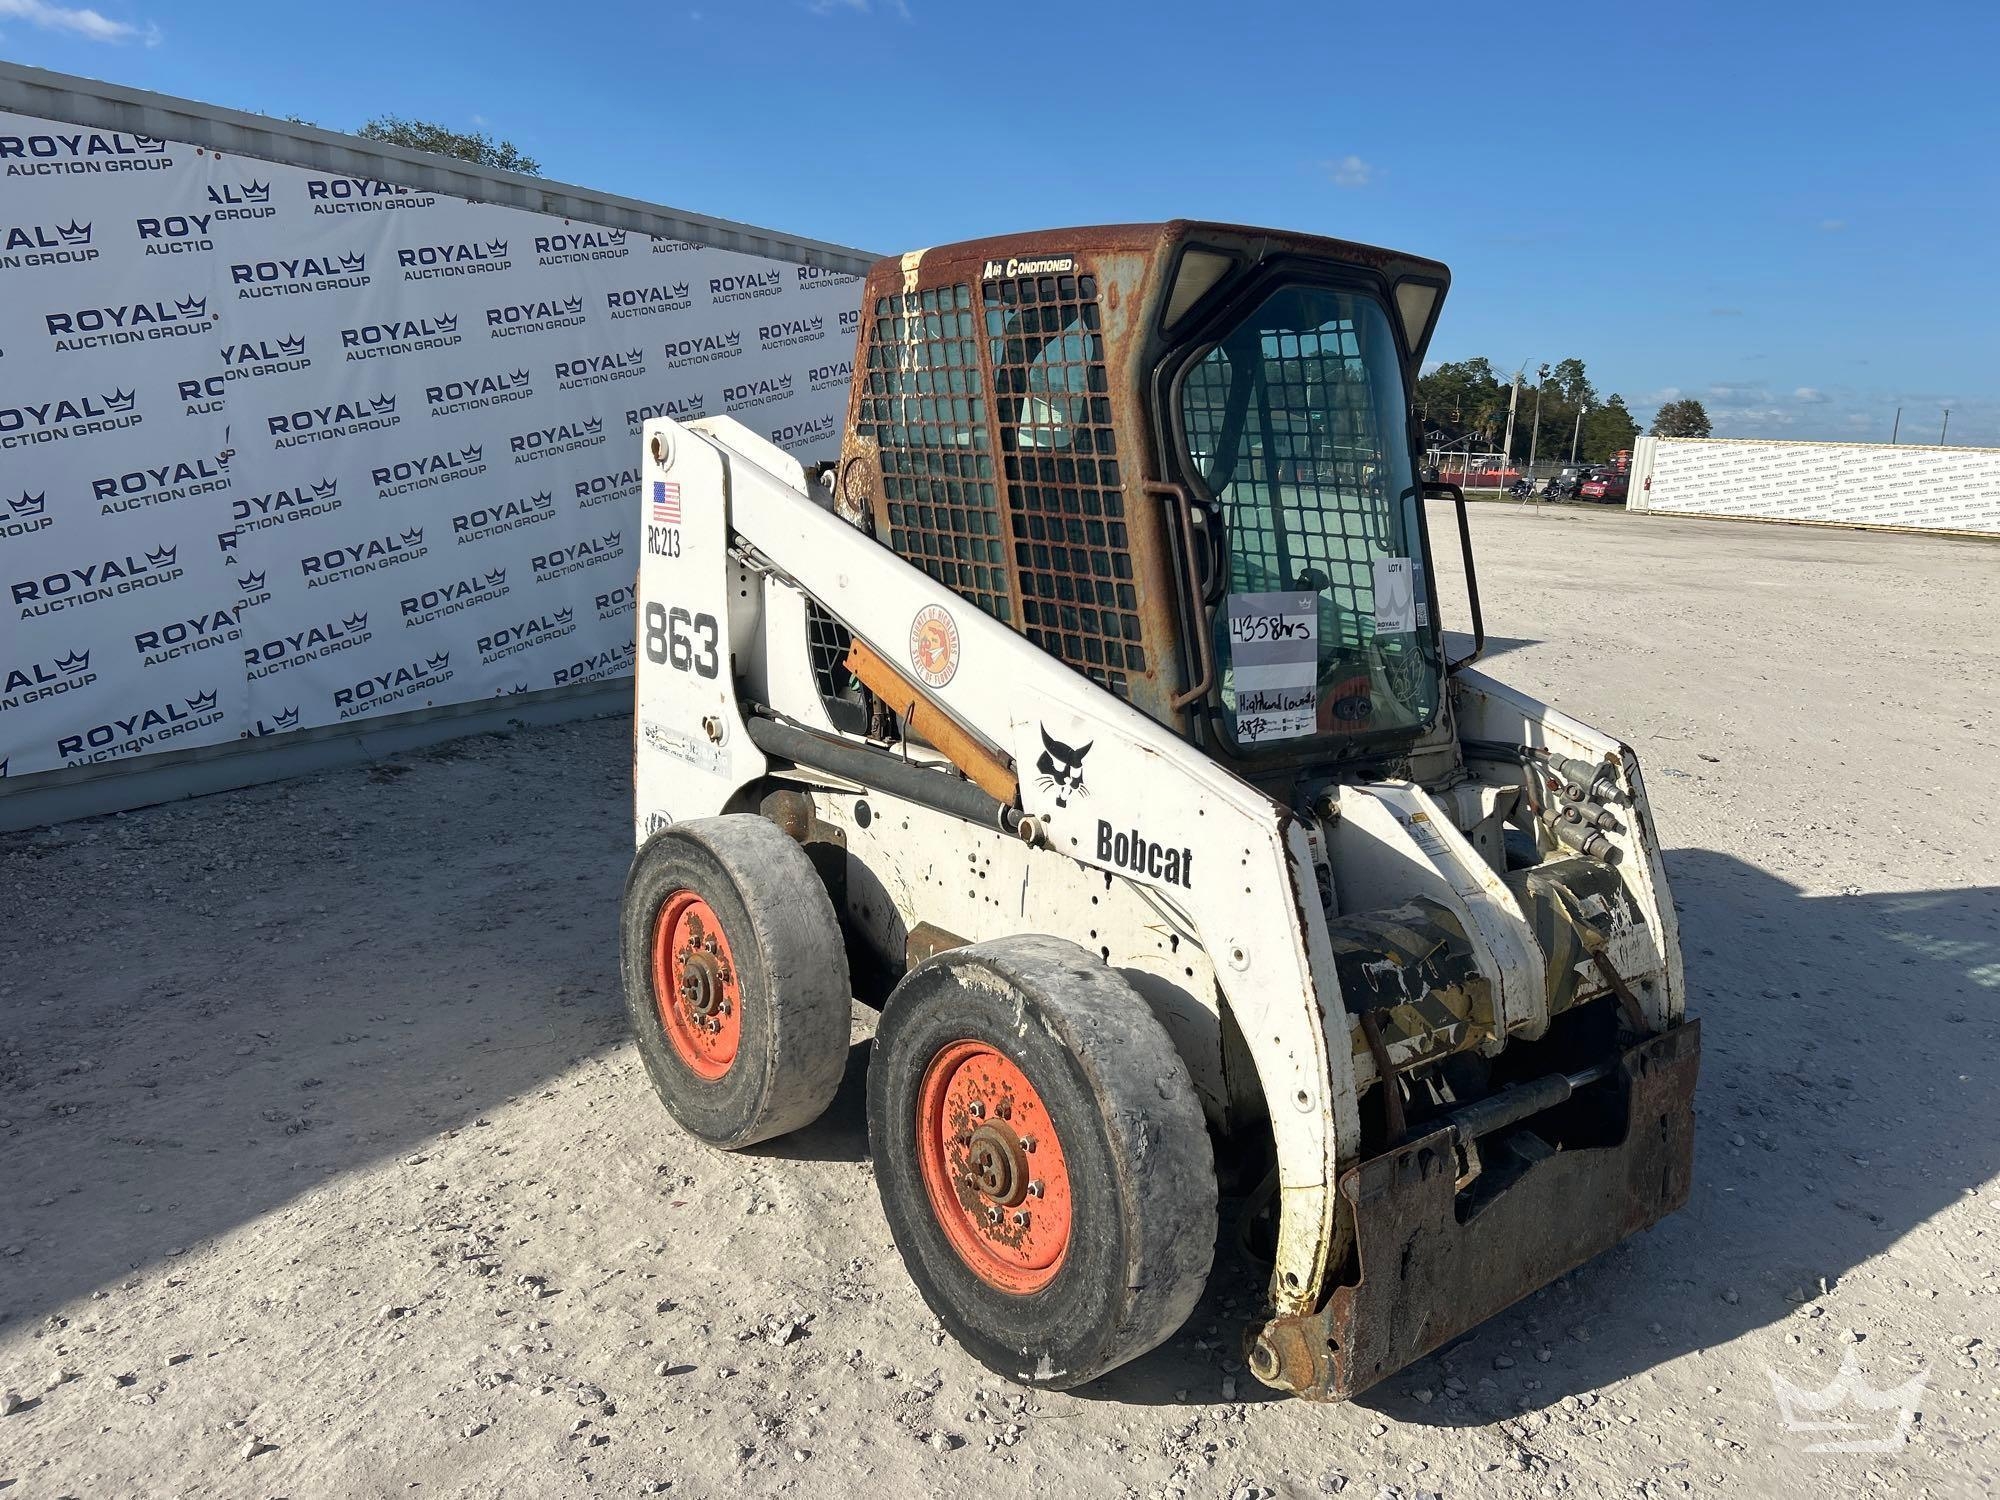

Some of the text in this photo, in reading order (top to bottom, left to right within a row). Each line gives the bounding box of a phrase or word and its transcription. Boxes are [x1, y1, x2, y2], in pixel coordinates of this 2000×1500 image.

[0, 134, 135, 157] ROYAL
[7, 158, 172, 176] AUCTION GROUP
[214, 207, 275, 220] GROUP
[314, 198, 435, 214] AUCTION GROUP
[137, 215, 211, 239] ROY
[398, 243, 487, 266] ROYAL
[535, 232, 609, 253] ROYAL
[25, 250, 100, 266] GROUP
[230, 257, 341, 284] ROYAL
[404, 262, 512, 281] AUCTION GROUP
[539, 249, 628, 266] AUCTION GROUP
[239, 277, 370, 299] AUCTION GROUP
[607, 286, 673, 308] ROYAL
[710, 273, 767, 294] ROYAL
[712, 287, 782, 304] AUCTION GROUP
[800, 276, 859, 290] AUCTION GROUP
[46, 302, 176, 335] ROYAL
[486, 301, 564, 326] ROYAL
[611, 301, 691, 320] AUCTION GROUP
[839, 311, 861, 325] RO
[56, 322, 212, 351] AUCTION GROUP
[341, 319, 435, 347] ROYAL
[491, 317, 586, 338] AUCTION GROUP
[759, 320, 811, 340] ROYAL
[762, 332, 824, 351] AUCTION GROUP
[346, 336, 461, 361] AUCTION GROUP
[665, 335, 725, 358] ROYAL
[668, 349, 742, 369] AUCTION GROUP
[253, 359, 311, 377] GROUP
[555, 354, 627, 379] ROYAL
[559, 367, 646, 391] AUCTION GROUP
[426, 375, 510, 404] ROYAL
[723, 379, 779, 403] ROYAL
[811, 378, 843, 392] AUCTION
[431, 389, 533, 417] AUCTION GROUP
[625, 400, 688, 425] ROYAL
[726, 391, 793, 413] AUCTION GROUP
[73, 414, 142, 436] GROUP
[268, 402, 371, 435] ROYAL
[275, 416, 400, 449] AUCTION GROUP
[772, 419, 822, 444] ROYAL
[510, 423, 584, 452] ROYAL
[514, 436, 606, 464] AUCTION GROUP
[779, 430, 836, 451] UCTION GROUP
[92, 460, 217, 500] ROYAL
[372, 452, 462, 486] ROYAL
[378, 465, 487, 499] AUCTION GROUP
[576, 469, 642, 498] ROYAL
[101, 488, 186, 516] AUCTION
[288, 500, 342, 521] GROUP
[579, 490, 627, 509] AUCTION
[453, 499, 533, 533] ROYAL
[457, 510, 556, 545] AUCTION GROUP
[532, 539, 604, 572] ROYAL
[648, 525, 680, 558] RC213
[301, 537, 401, 576] ROYAL
[308, 547, 428, 589] AUCTION GROUP
[536, 549, 624, 584] AUCTION GROUP
[1388, 564, 1398, 572] LOT
[11, 557, 147, 604] ROYAL
[20, 569, 183, 620] AUCTION GROUP
[400, 577, 486, 616] ROYAL
[406, 587, 509, 628] AUCTION GROUP
[477, 616, 554, 654] ROYAL
[646, 601, 718, 680] 863
[1232, 614, 1310, 642] 4358hrs
[143, 634, 224, 667] AUCTION
[244, 624, 344, 667] ROYAL
[247, 632, 372, 681] AUCTION GROUP
[483, 624, 576, 666] AUCTION GROUP
[553, 648, 622, 685] ROYAL
[24, 673, 97, 703] GROUP
[334, 663, 428, 707] ROYAL
[340, 671, 454, 720] AUCTION GROUP
[57, 703, 188, 758] ROYAL
[67, 736, 154, 768] AUCTION
[157, 712, 224, 740] GROUP
[1096, 819, 1192, 889] Bobcat
